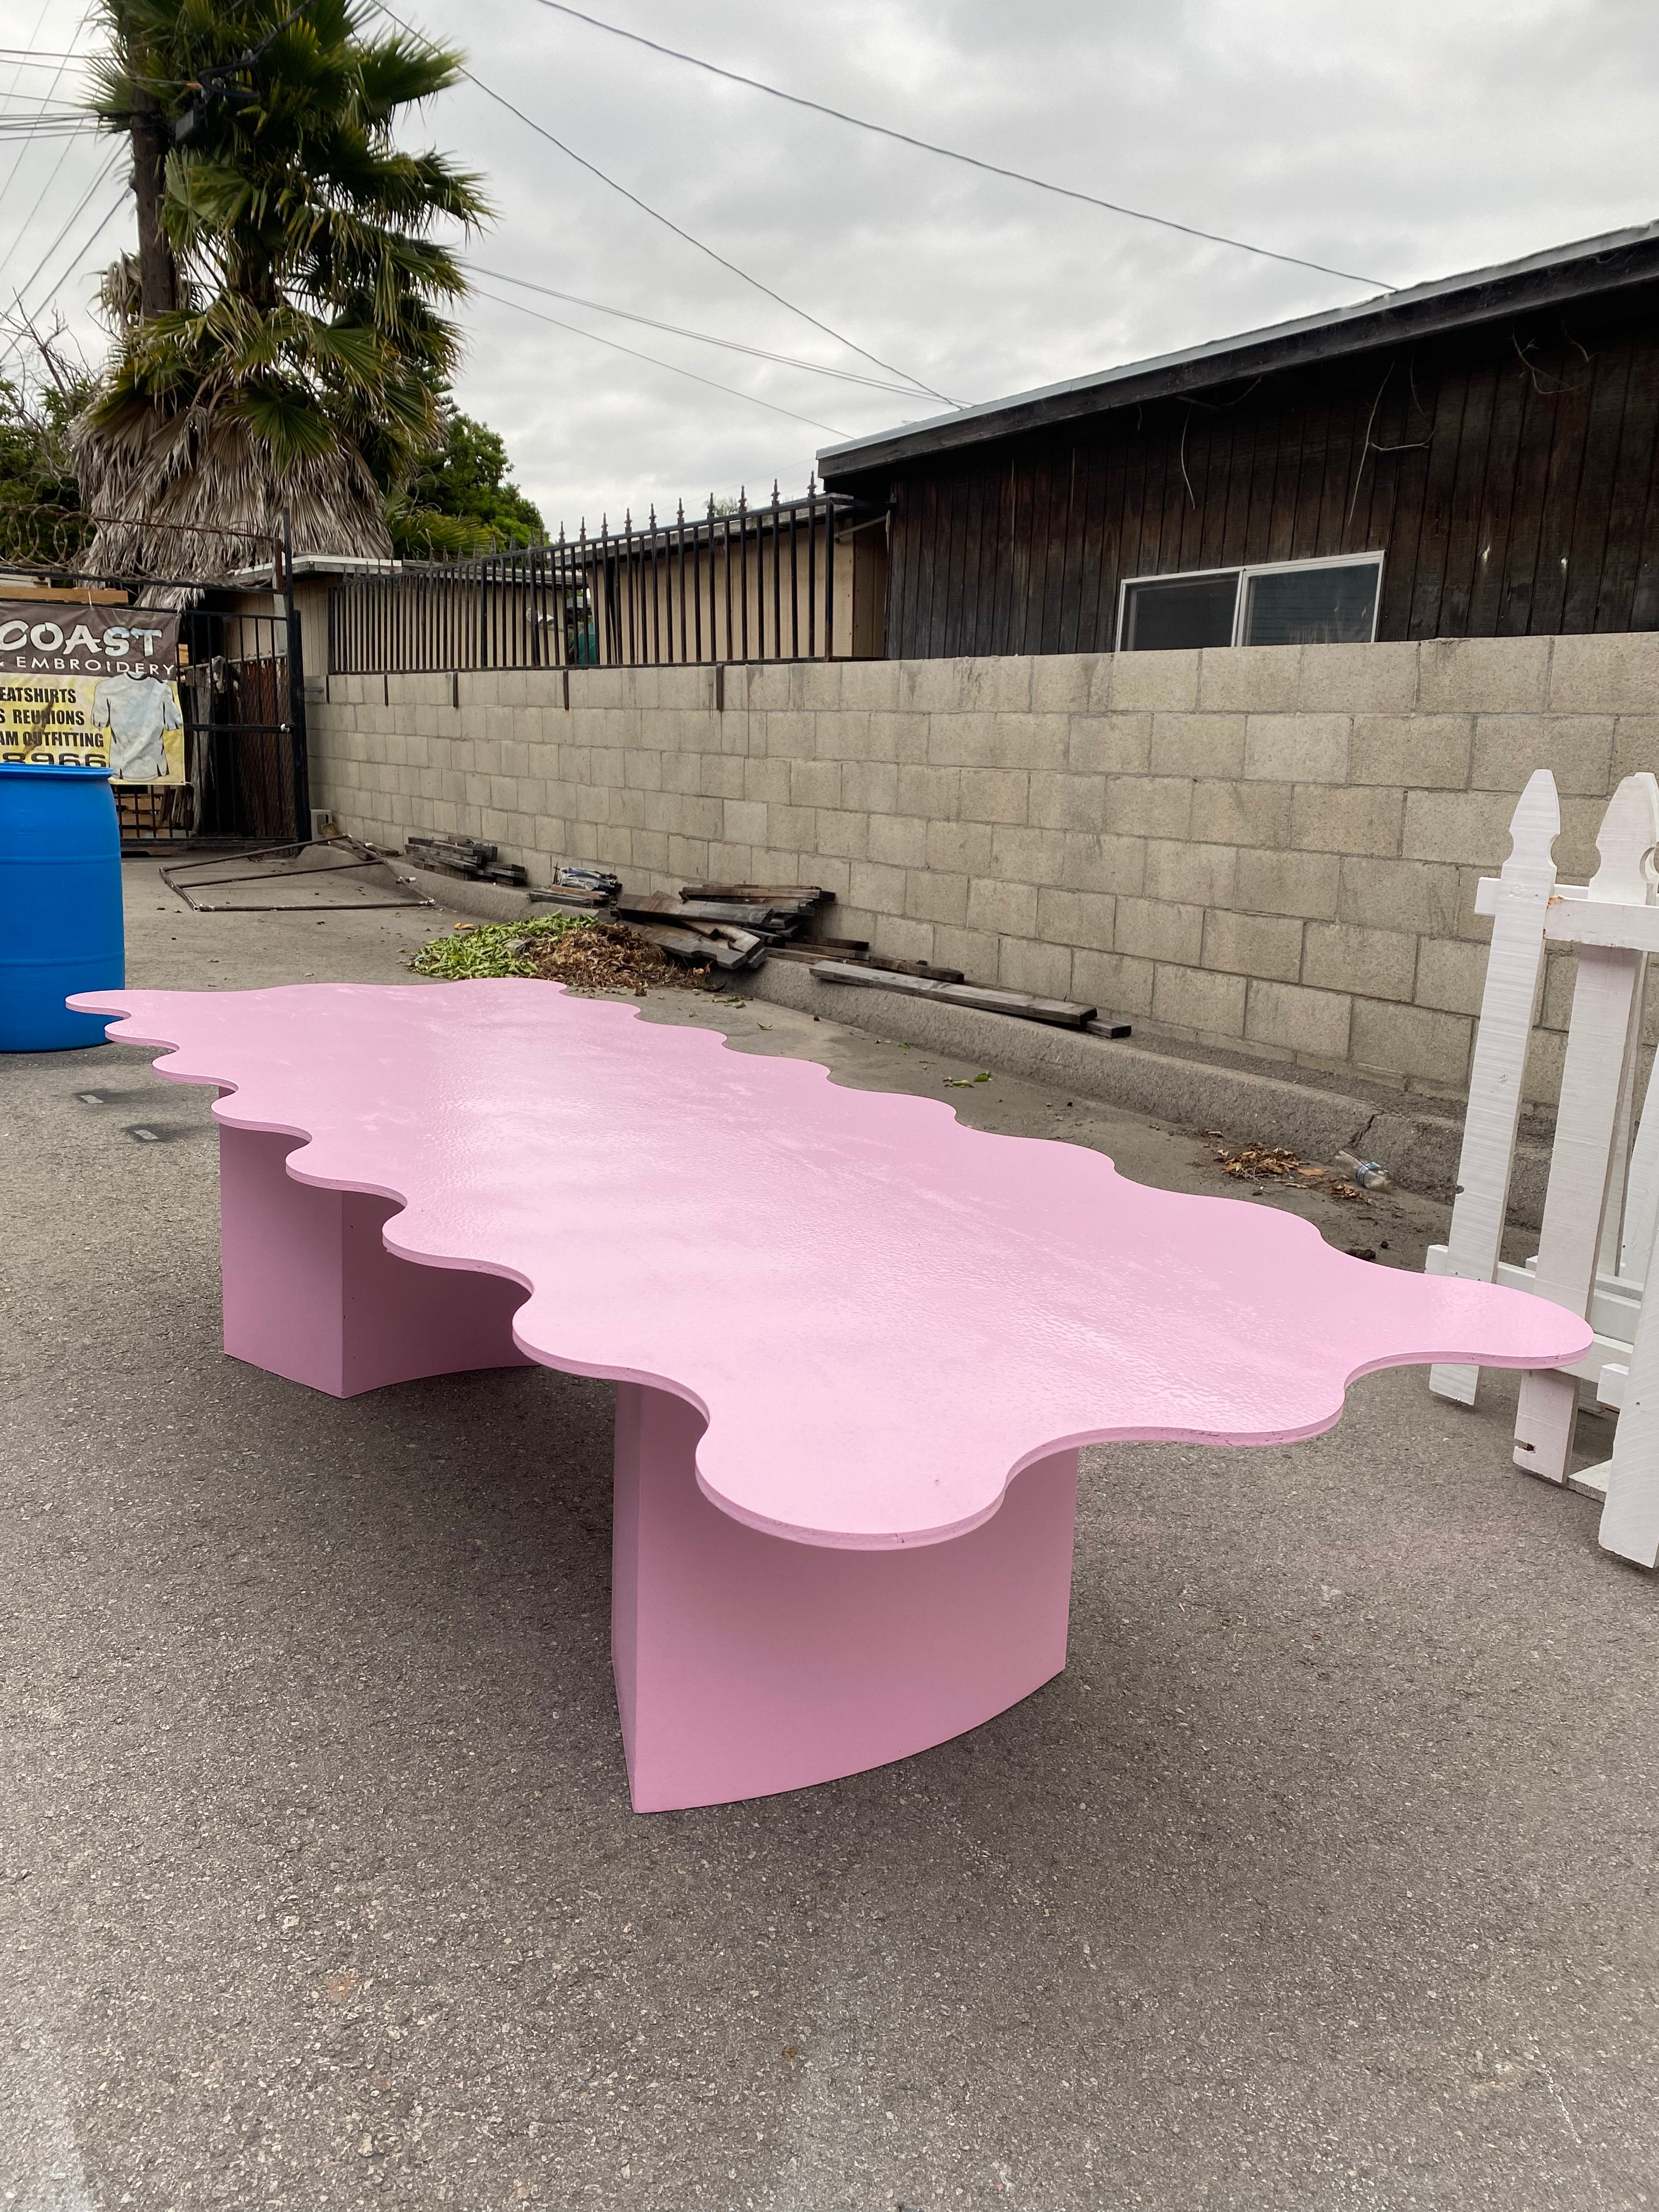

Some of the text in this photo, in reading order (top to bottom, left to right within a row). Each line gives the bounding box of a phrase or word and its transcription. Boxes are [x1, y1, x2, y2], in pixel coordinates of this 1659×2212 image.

[0, 619, 162, 657] COAST
[16, 656, 174, 675] EMBROIDERY
[23, 731, 104, 747] OUTFITTING
